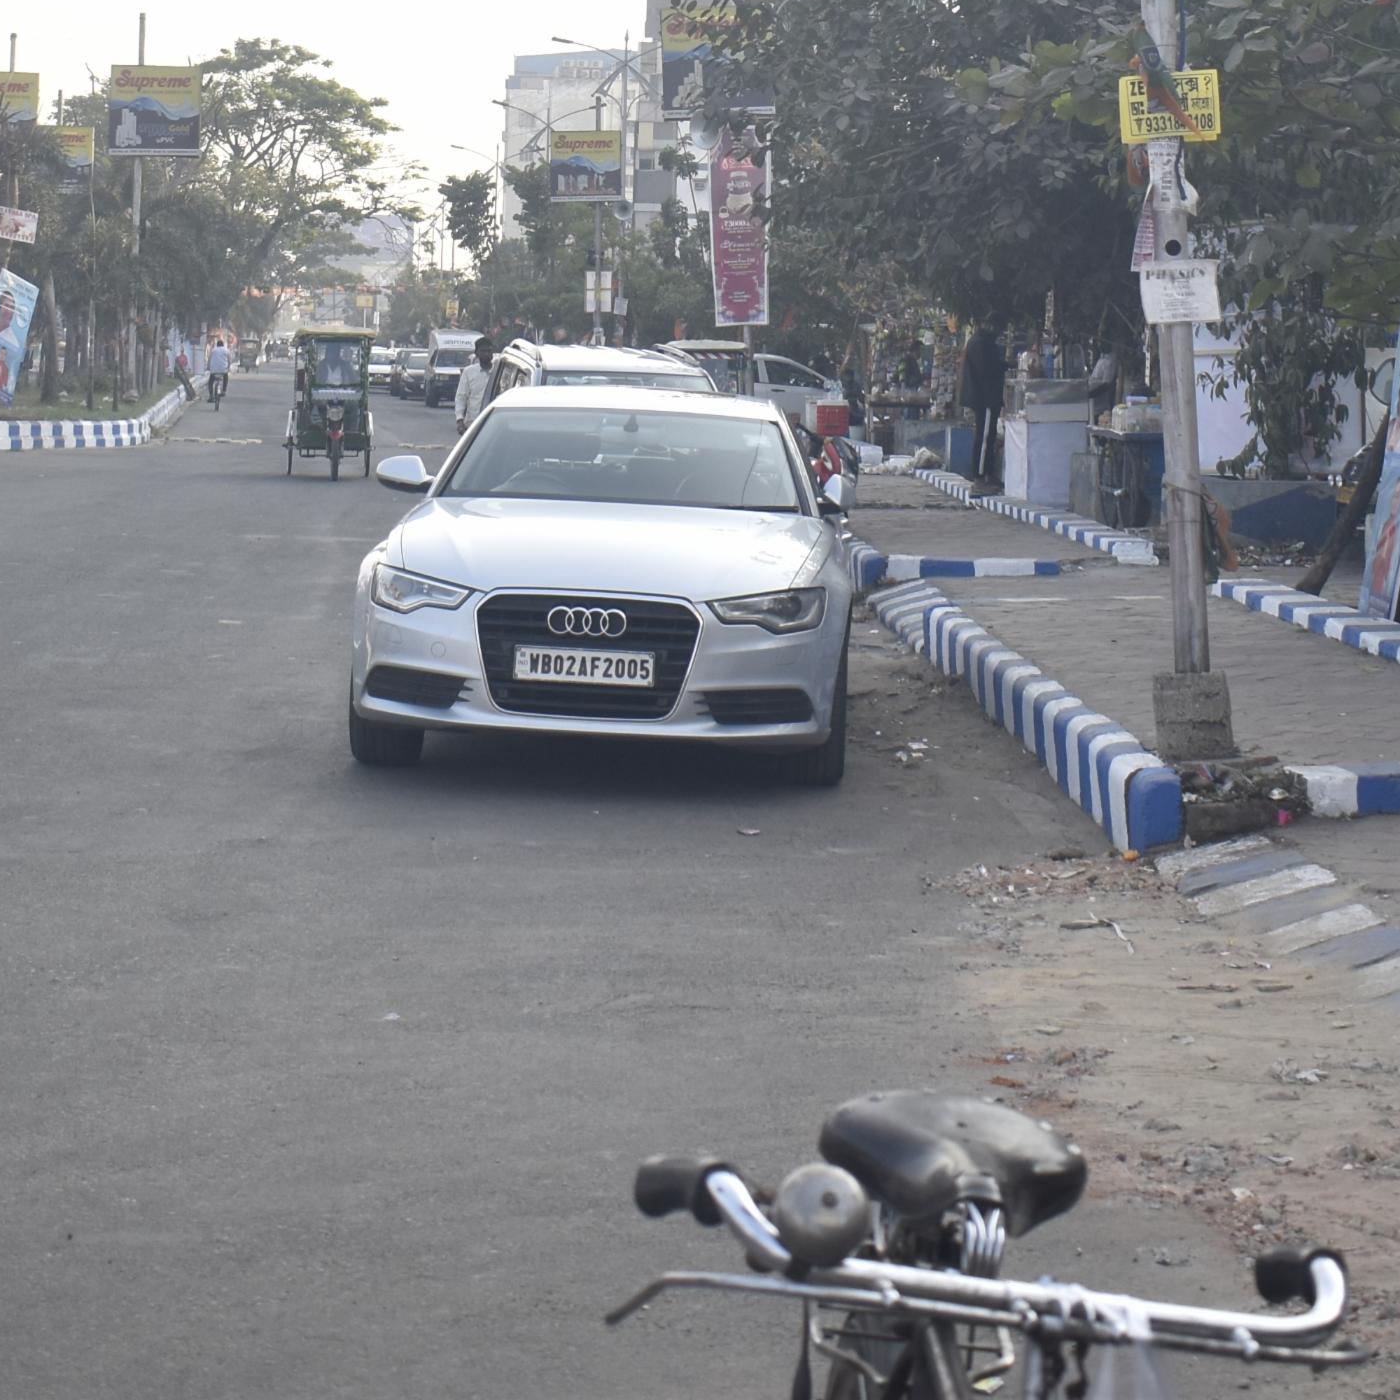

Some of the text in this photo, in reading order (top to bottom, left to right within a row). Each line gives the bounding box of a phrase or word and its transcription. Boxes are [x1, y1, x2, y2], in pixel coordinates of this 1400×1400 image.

[115, 69, 192, 93] Supreme
[1145, 113, 1214, 134] 933184108
[529, 652, 650, 680] WB02AF2005
